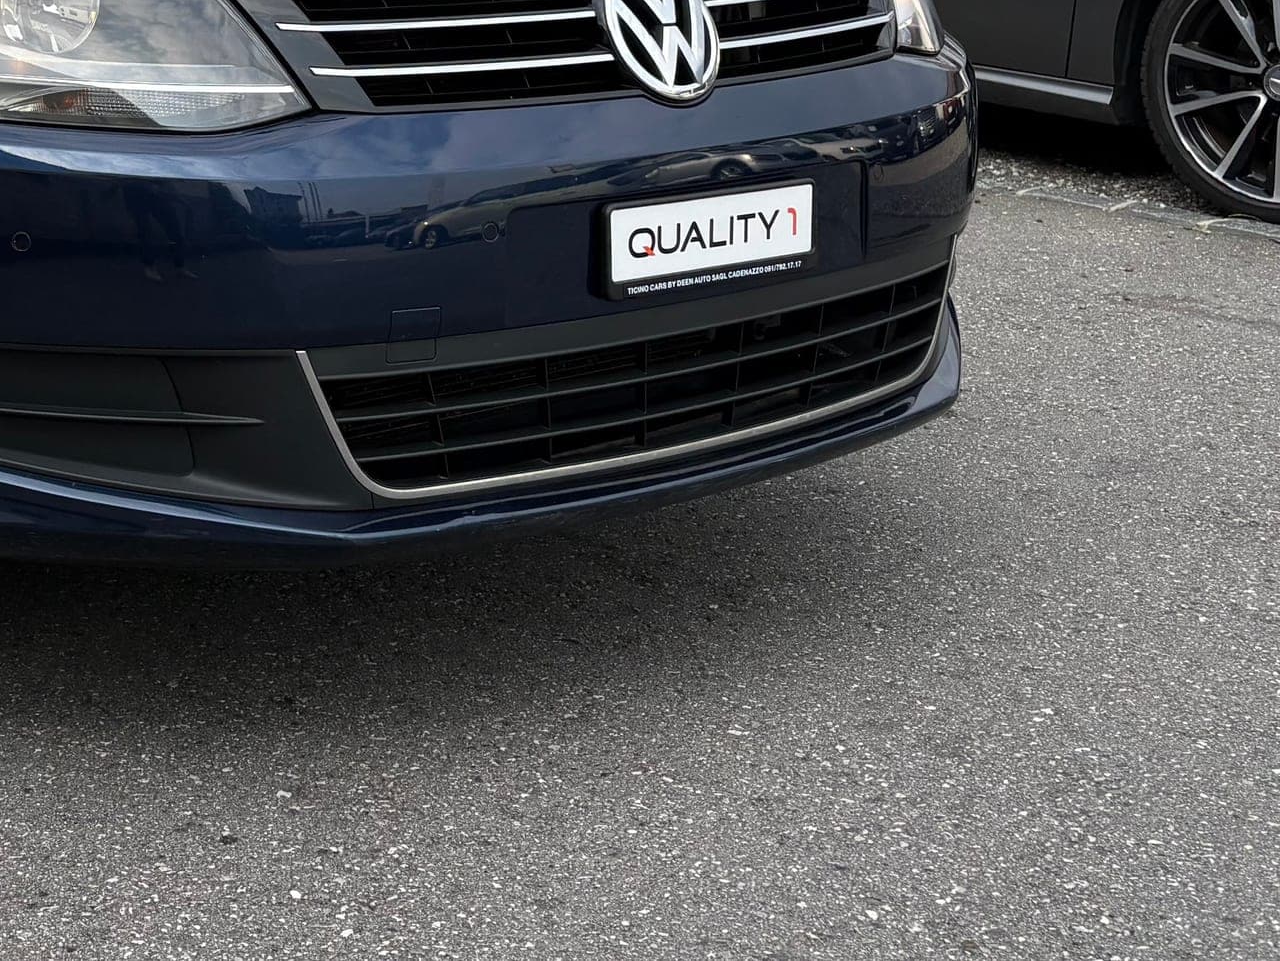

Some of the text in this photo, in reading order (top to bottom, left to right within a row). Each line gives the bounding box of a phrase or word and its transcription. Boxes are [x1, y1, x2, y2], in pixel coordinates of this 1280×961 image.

[628, 207, 797, 258] QUALITY 1
[649, 281, 667, 291] CARS
[694, 275, 711, 284] AUTO
